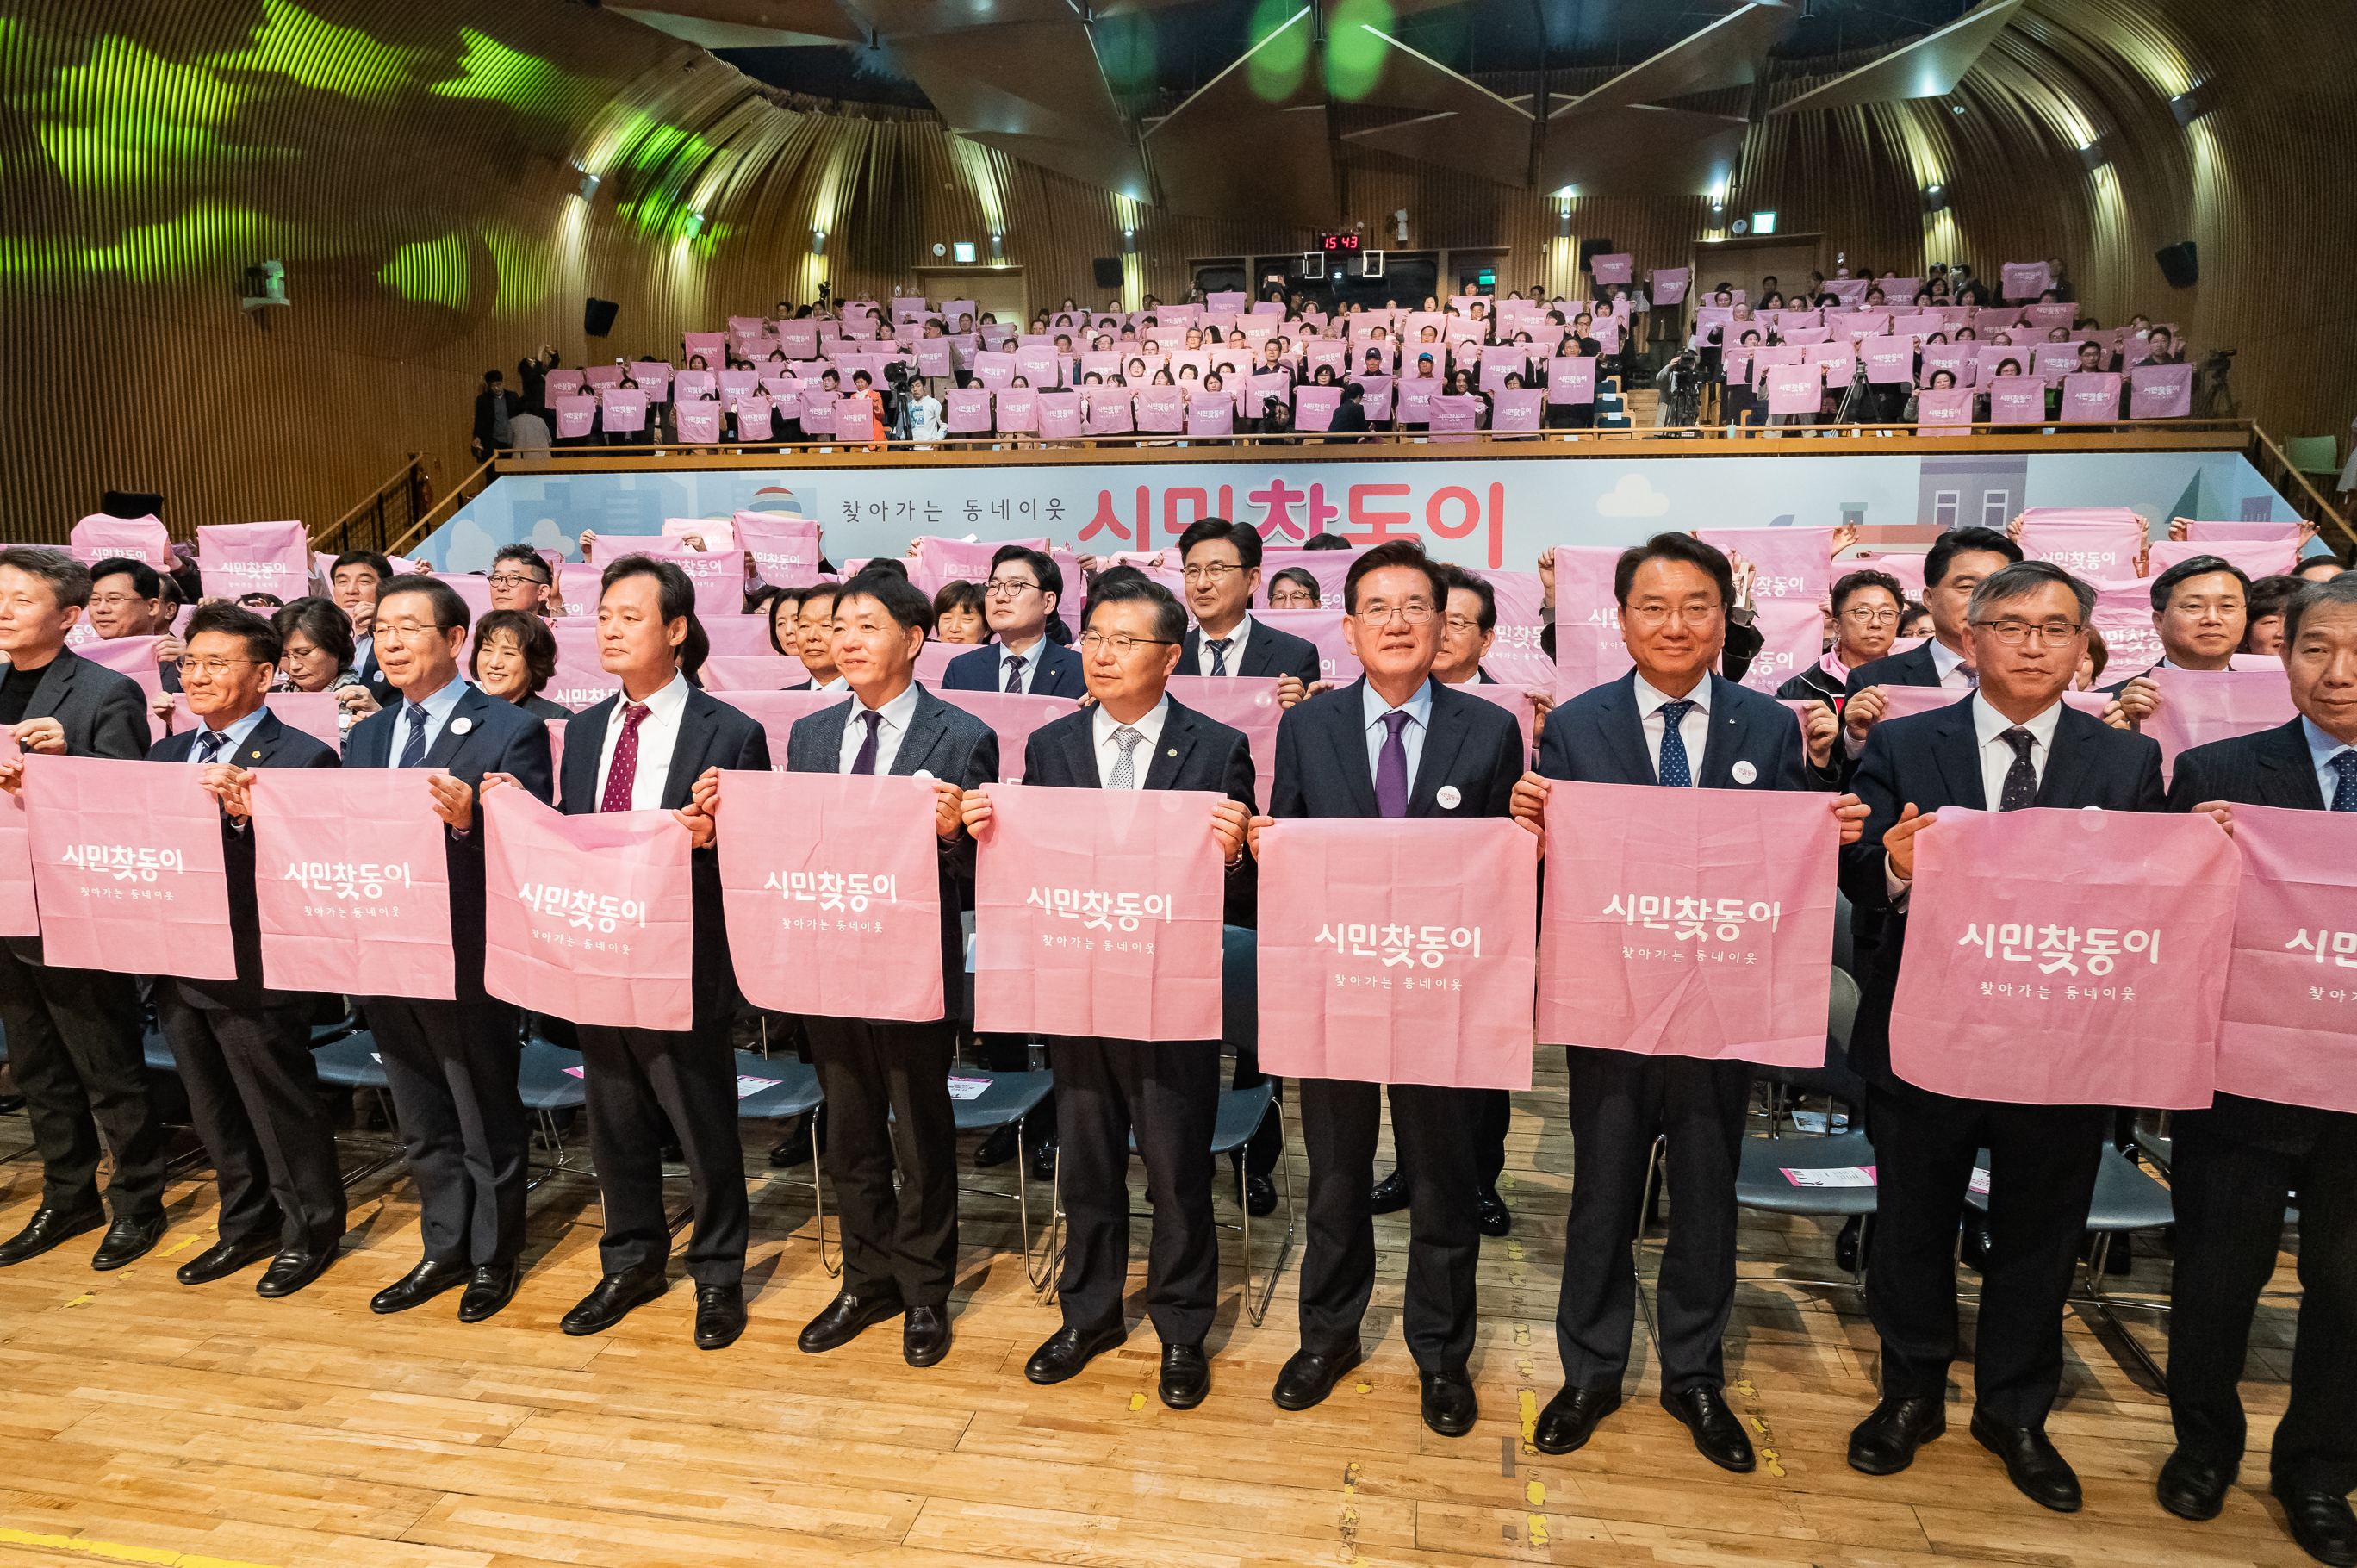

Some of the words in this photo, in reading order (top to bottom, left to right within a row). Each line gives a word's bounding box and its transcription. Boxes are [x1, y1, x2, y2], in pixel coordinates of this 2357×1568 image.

[1324, 236, 1336, 249] 15
[1341, 235, 1359, 249] 43
[843, 500, 942, 522] 찾아가는
[963, 498, 1066, 522] 동네이웃
[220, 562, 286, 579] 시민찾동이
[1751, 575, 1804, 597] 찾동이
[61, 843, 183, 883] 시민찾동이
[283, 861, 411, 901] 시민찾동이
[763, 870, 898, 913] 시민찾동이
[79, 886, 123, 899] 찾아가는
[130, 887, 174, 901] 동네이웃
[303, 905, 347, 918] 찾아가는
[353, 905, 401, 918] 동네이웃
[518, 881, 646, 934] 시민찾동이
[1026, 886, 1172, 933] 시민찾동이
[1602, 893, 1781, 943] 시민찾동이
[781, 917, 830, 932] 찾아가는
[836, 918, 884, 934] 동네이웃
[532, 928, 575, 948] 찾아가는
[583, 936, 631, 956] 동네이웃
[1042, 933, 1095, 950] 찾아가는
[1103, 937, 1156, 955] 동네이웃
[1315, 921, 1481, 970] 시민찾동이
[1957, 922, 2161, 977] 시민찾동이
[1622, 946, 1684, 963] 찾아가는
[1695, 949, 1758, 966] 동네이웃
[1334, 973, 1393, 990] 찾아가는
[1403, 975, 1464, 992] 동네이웃
[1980, 980, 2052, 1000] 찾아가는
[2064, 985, 2136, 1002] 동네이웃
